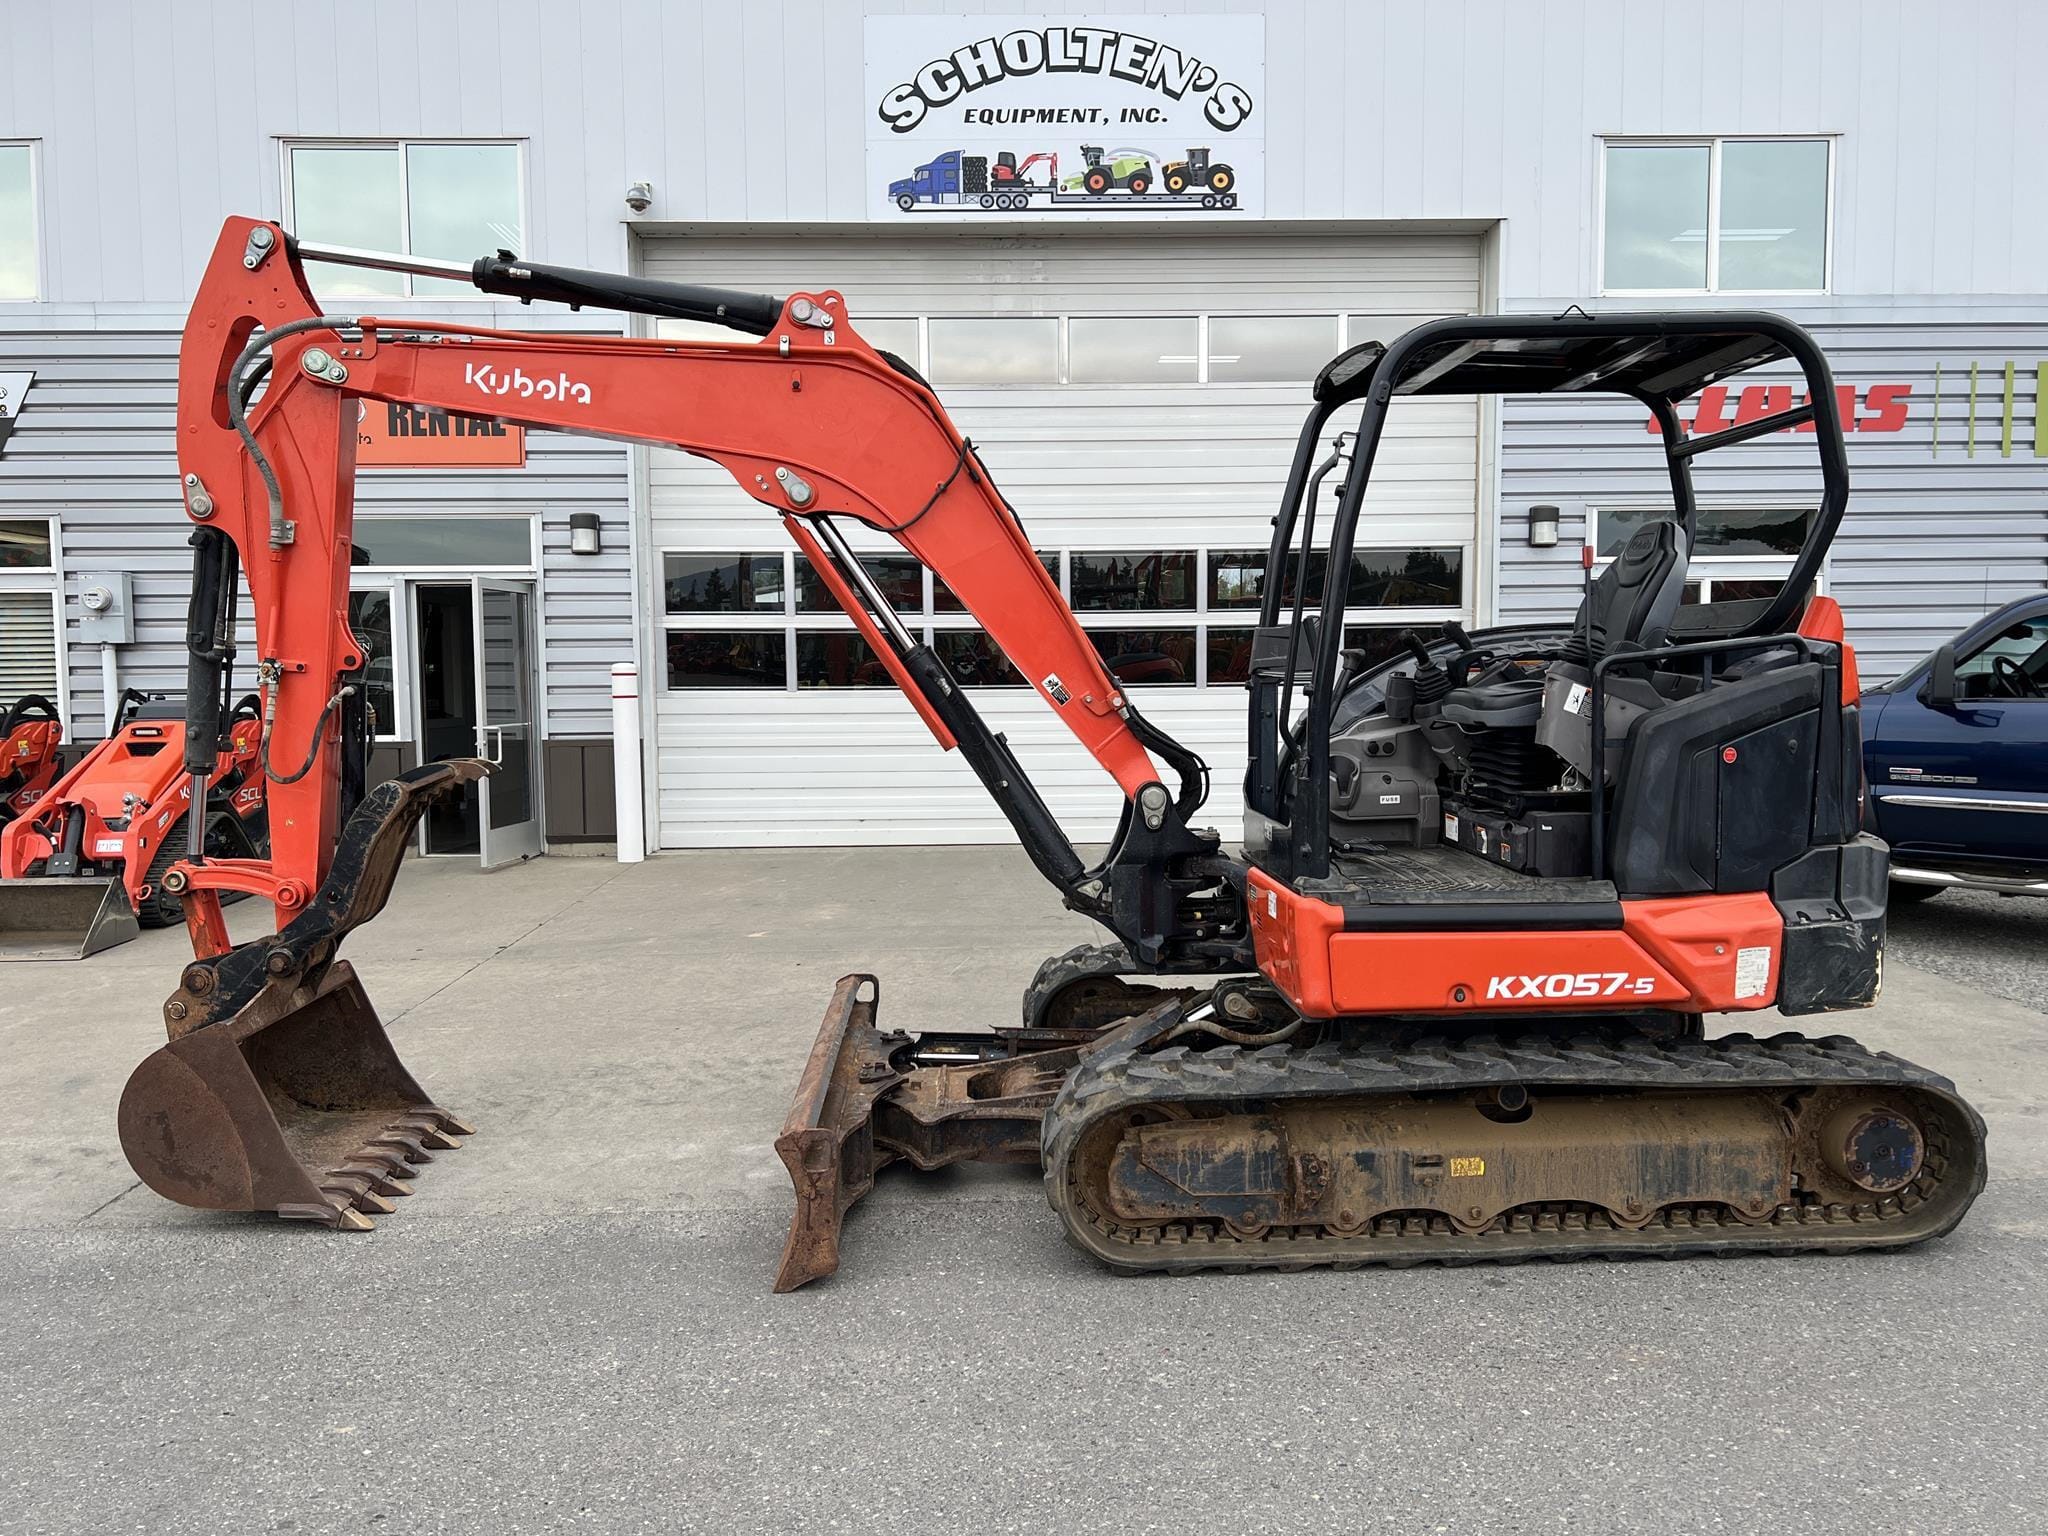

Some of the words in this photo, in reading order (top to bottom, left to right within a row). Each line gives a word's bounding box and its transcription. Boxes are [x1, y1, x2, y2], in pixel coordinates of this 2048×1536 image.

[878, 27, 1253, 133] SCHOLTEN'S
[964, 108, 1108, 125] EQUIPMENT,
[1120, 108, 1168, 123] INC.
[465, 363, 591, 404] Kubota
[1486, 972, 1655, 999] KX057-5
